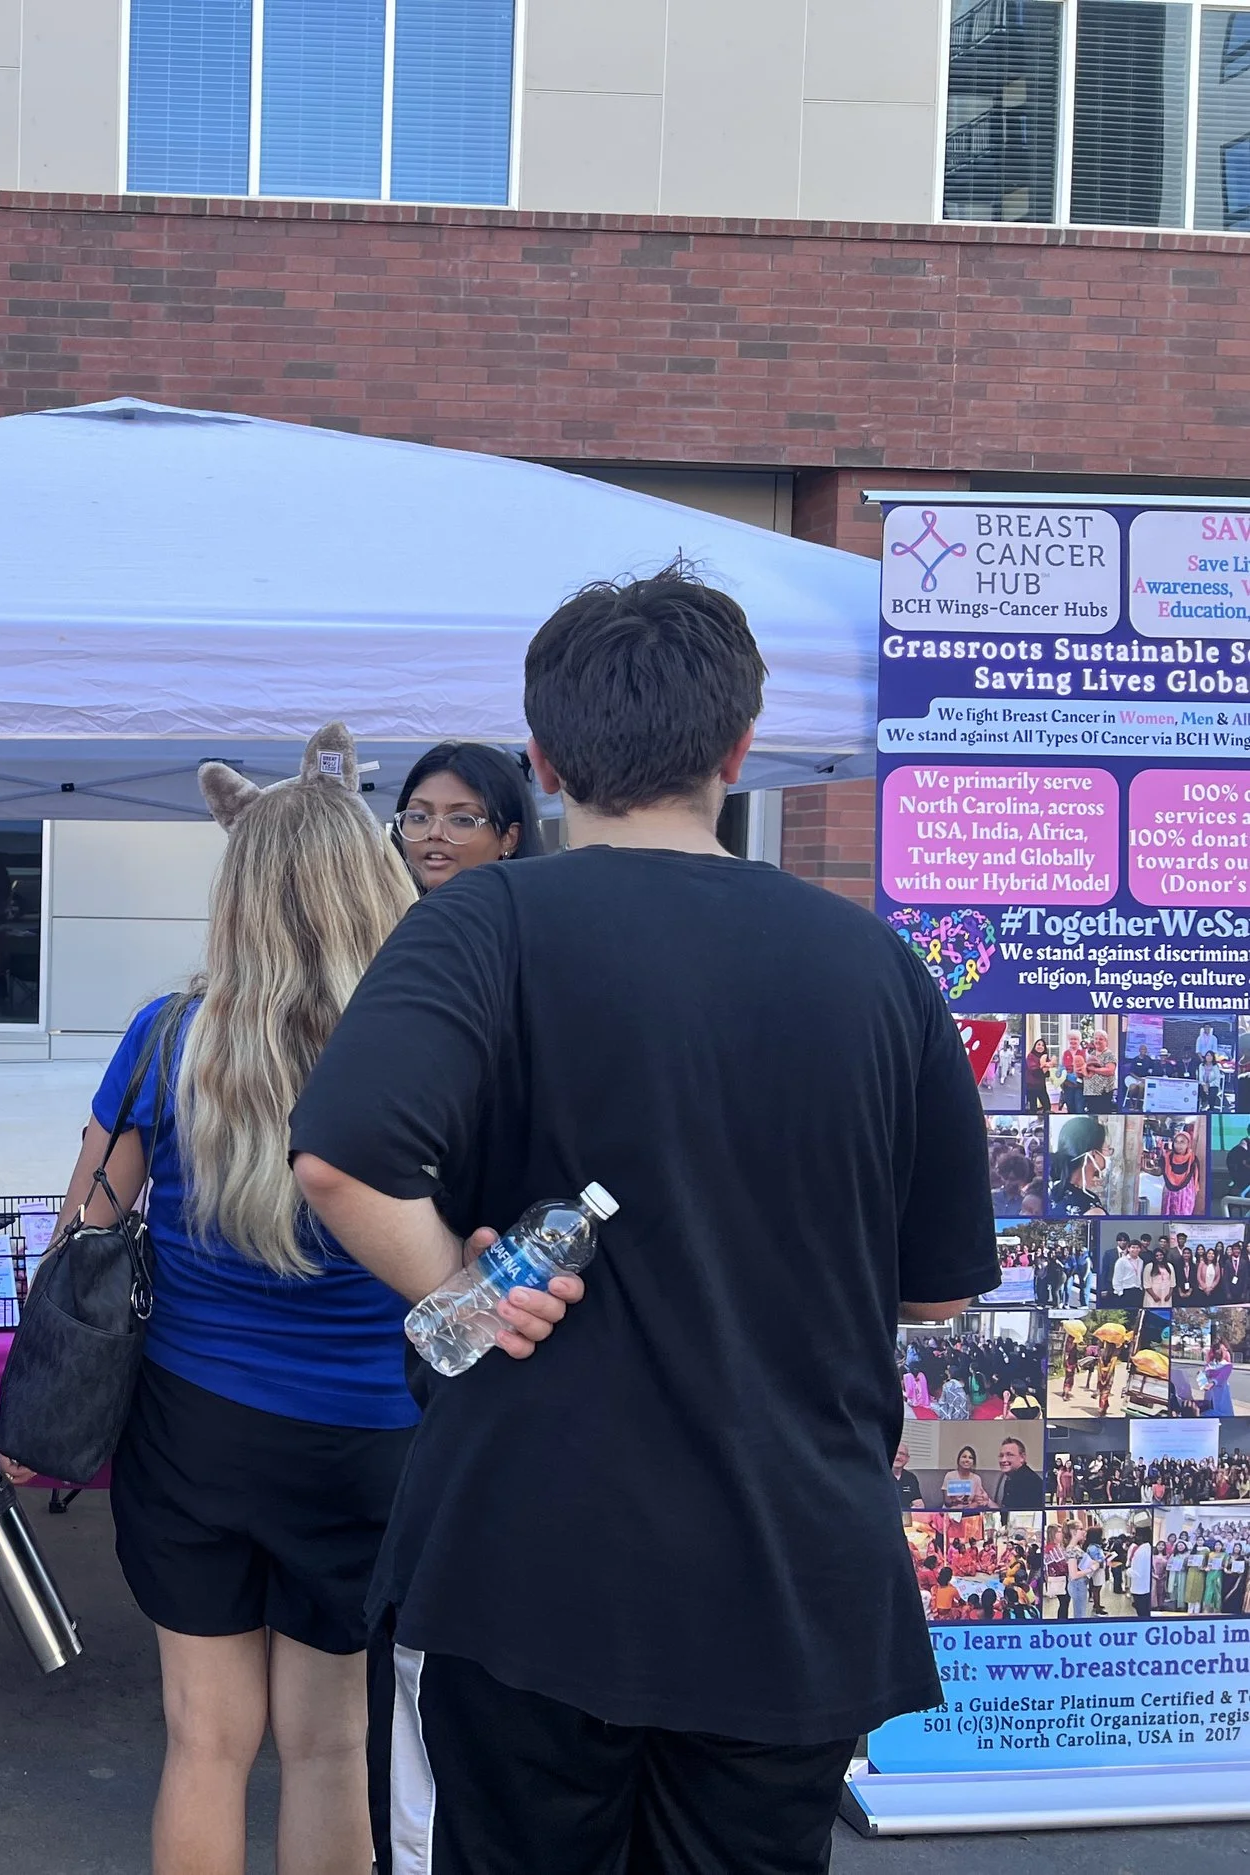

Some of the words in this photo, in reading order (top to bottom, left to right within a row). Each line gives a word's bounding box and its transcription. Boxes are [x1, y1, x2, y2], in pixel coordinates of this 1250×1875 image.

[976, 513, 1093, 538] BREAST
[976, 542, 1106, 567] CANCER
[1187, 555, 1229, 572] Save
[976, 572, 1041, 595] HUB
[1133, 576, 1233, 598] Awareness,
[891, 599, 931, 614] BCH
[936, 600, 1059, 619] Wings-Cancer
[1064, 602, 1108, 617] Hubs
[883, 635, 1043, 661] Grassroots
[1054, 638, 1220, 663] Sustainable
[974, 667, 1072, 696] Saving
[1083, 669, 1156, 692] Lives
[1167, 669, 1250, 694] Globa
[938, 707, 964, 722] We
[966, 708, 999, 725] fight
[1002, 709, 1048, 723] Breast
[1051, 710, 1100, 724] Cancer
[1103, 710, 1116, 724] in
[1119, 710, 1178, 726] Women,
[1181, 712, 1214, 725] Men
[1217, 712, 1229, 725] &
[886, 728, 915, 742] We
[918, 728, 957, 743] stand
[960, 730, 1009, 747] against
[1012, 729, 1033, 744] All
[1036, 730, 1078, 747] Types
[1082, 730, 1101, 744] Of
[1101, 732, 1150, 746] Cancer
[1152, 732, 1172, 745] via
[1175, 732, 1209, 746] BCH
[913, 770, 950, 789] We
[954, 771, 1040, 795] primarily
[1043, 775, 1092, 791] serve
[1183, 783, 1239, 802] 100%
[899, 796, 958, 815] North
[962, 797, 1044, 818] Carolina,
[1048, 801, 1105, 817] across
[1154, 807, 1237, 825] services
[916, 821, 968, 842] USA,
[971, 822, 1023, 842] India,
[1027, 822, 1089, 843] Africa,
[1129, 828, 1186, 847] 100%
[1191, 829, 1250, 848] donat
[908, 847, 979, 870] Turkey
[982, 847, 1017, 867] and
[1020, 847, 1095, 871] Globally
[1136, 852, 1219, 870] towards
[894, 872, 942, 890] with
[945, 876, 978, 891] our
[982, 873, 1048, 896] Hybrid
[1051, 873, 1110, 892] Model
[1000, 906, 1250, 941] #TogetherWeSa
[1000, 942, 1033, 961] We
[1037, 942, 1085, 961] stand
[1088, 943, 1151, 967] against
[1154, 943, 1250, 963] discrimina
[1018, 968, 1092, 989] religion,
[1095, 967, 1178, 991] language,
[1181, 968, 1246, 986] culture
[1090, 992, 1123, 1009] We
[1126, 996, 1175, 1009] serve
[1178, 992, 1250, 1010] Humani
[930, 1632, 957, 1651] To
[964, 1630, 1022, 1650] learn
[1029, 1629, 1092, 1649] about
[1101, 1631, 1138, 1647] our
[1145, 1624, 1216, 1645] Global
[940, 1660, 977, 1682] sit:
[954, 1702, 963, 1713] a
[969, 1696, 1055, 1713] GuideStar
[1060, 1694, 1135, 1710] Platinum
[1141, 1690, 1214, 1707] Certified
[1220, 1691, 1232, 1704] &
[924, 1717, 951, 1732] 501
[1090, 1711, 1204, 1730] Organization,
[977, 1735, 994, 1750] in
[1000, 1733, 1050, 1750] North
[1056, 1731, 1131, 1748] Carolina,
[1138, 1729, 1173, 1744] USA
[1178, 1729, 1195, 1743] in
[1205, 1726, 1241, 1742] 2017
